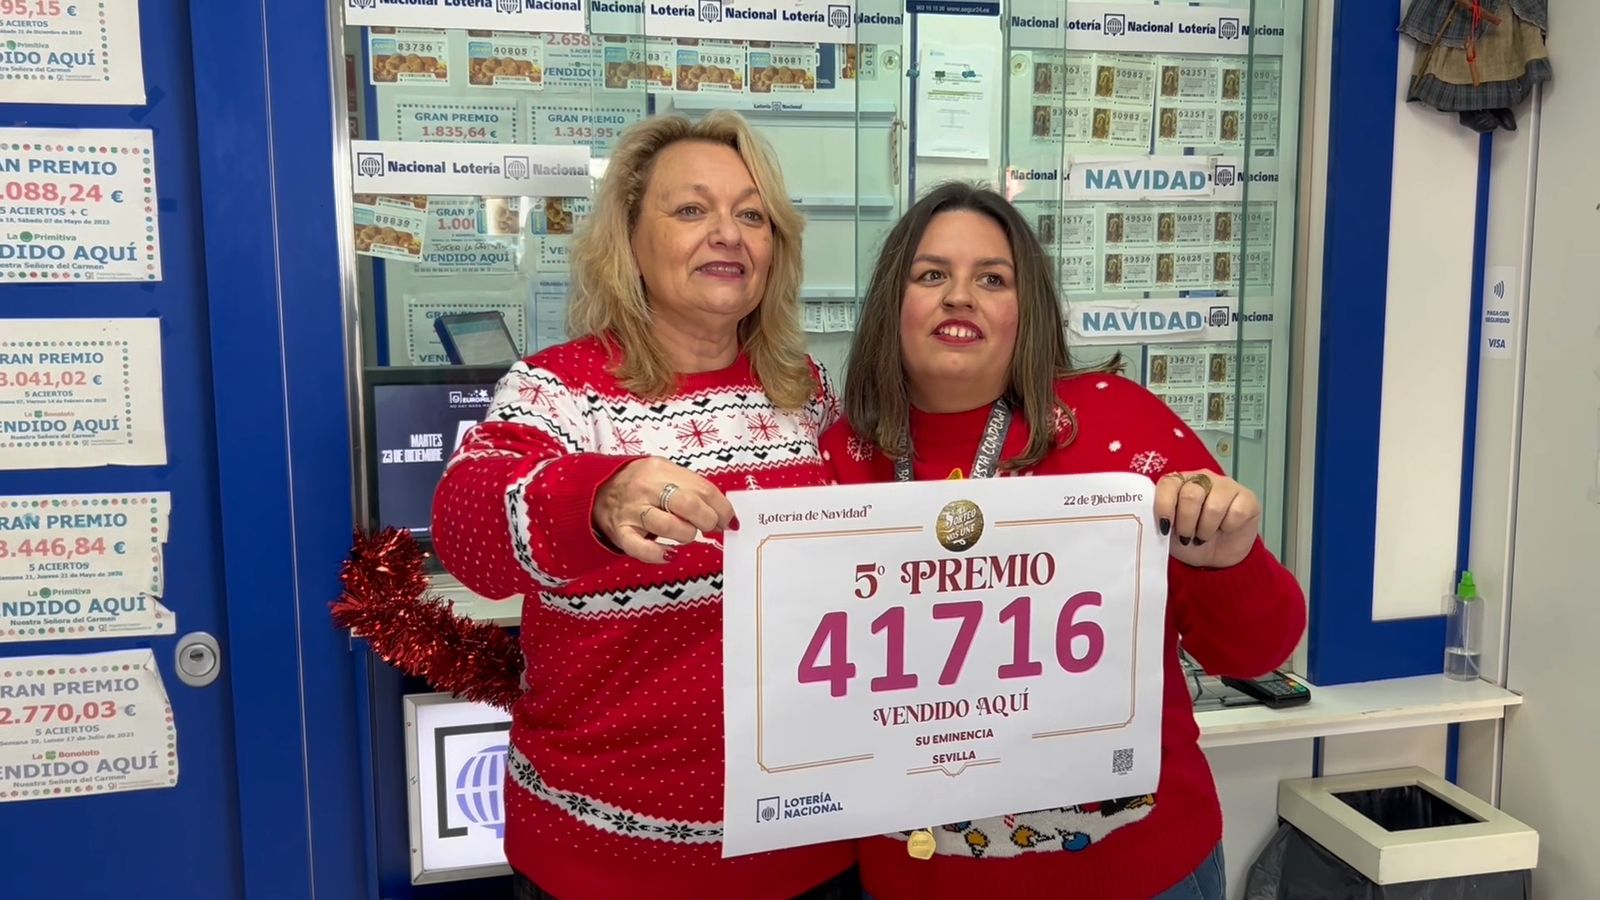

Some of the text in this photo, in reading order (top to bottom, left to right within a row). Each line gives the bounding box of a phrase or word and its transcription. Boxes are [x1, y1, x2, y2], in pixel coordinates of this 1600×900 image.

[525, 1, 580, 11] Nacional
[651, 3, 696, 17] Lotería
[726, 8, 777, 20] Nacional
[782, 11, 825, 22] Lotería
[1012, 16, 1059, 29] Nacional
[1128, 21, 1174, 33] Nacional
[1178, 23, 1217, 35] Lotería
[0, 49, 97, 69] IDO AQUÍ
[415, 111, 499, 124] GRAN PREMIO
[548, 114, 580, 124] GRAN
[421, 126, 487, 139] 1.835,64
[29, 160, 118, 176] PREMIO
[388, 160, 589, 178] Nacional Lotería Nacional
[1086, 168, 1207, 190] NAVIDAD
[10, 207, 67, 216] ACIERTOS
[436, 208, 465, 218] GRAN
[7, 233, 78, 242] La Primitiva
[73, 241, 138, 265] AQUÍ
[422, 251, 511, 264] VENDIDO AQUÍ
[24, 262, 57, 270] Señora
[1083, 311, 1203, 332] NAVIDAD
[1488, 338, 1506, 349] VISA
[39, 352, 104, 365] PREMIO
[32, 390, 74, 398] ACIERTOS
[0, 415, 120, 435] NDIDO AQUÍ
[411, 434, 443, 448] MARTES
[382, 449, 393, 464] 23
[393, 449, 404, 463] DE
[1064, 492, 1143, 507] 22 de Diciembre
[805, 510, 819, 521] de
[822, 504, 873, 520] Navidad
[47, 513, 127, 530] PREMIO
[38, 561, 89, 572] ACIERTOS
[900, 552, 1056, 598] PREMIO
[27, 587, 91, 598] La Primitiva
[0, 599, 81, 617] NDIDO
[10, 618, 42, 626] Nuestra
[43, 616, 71, 625] Señora
[797, 591, 1105, 698] 41716
[53, 677, 140, 696] PREMIO
[0, 700, 117, 726] 2.770,03
[873, 687, 1030, 727] VENDIDO AQUÍ
[35, 725, 99, 737] 5 ACIERTOS
[915, 729, 994, 747] SU EMINENCIA
[32, 749, 99, 761] La Bonoloto
[932, 750, 976, 764] SEVILLA
[96, 750, 159, 776] AQUÍ
[13, 774, 126, 789] Nuestra Señora del Carmen
[784, 792, 832, 808] LOTERÍA
[784, 802, 843, 819] NACIONAL
